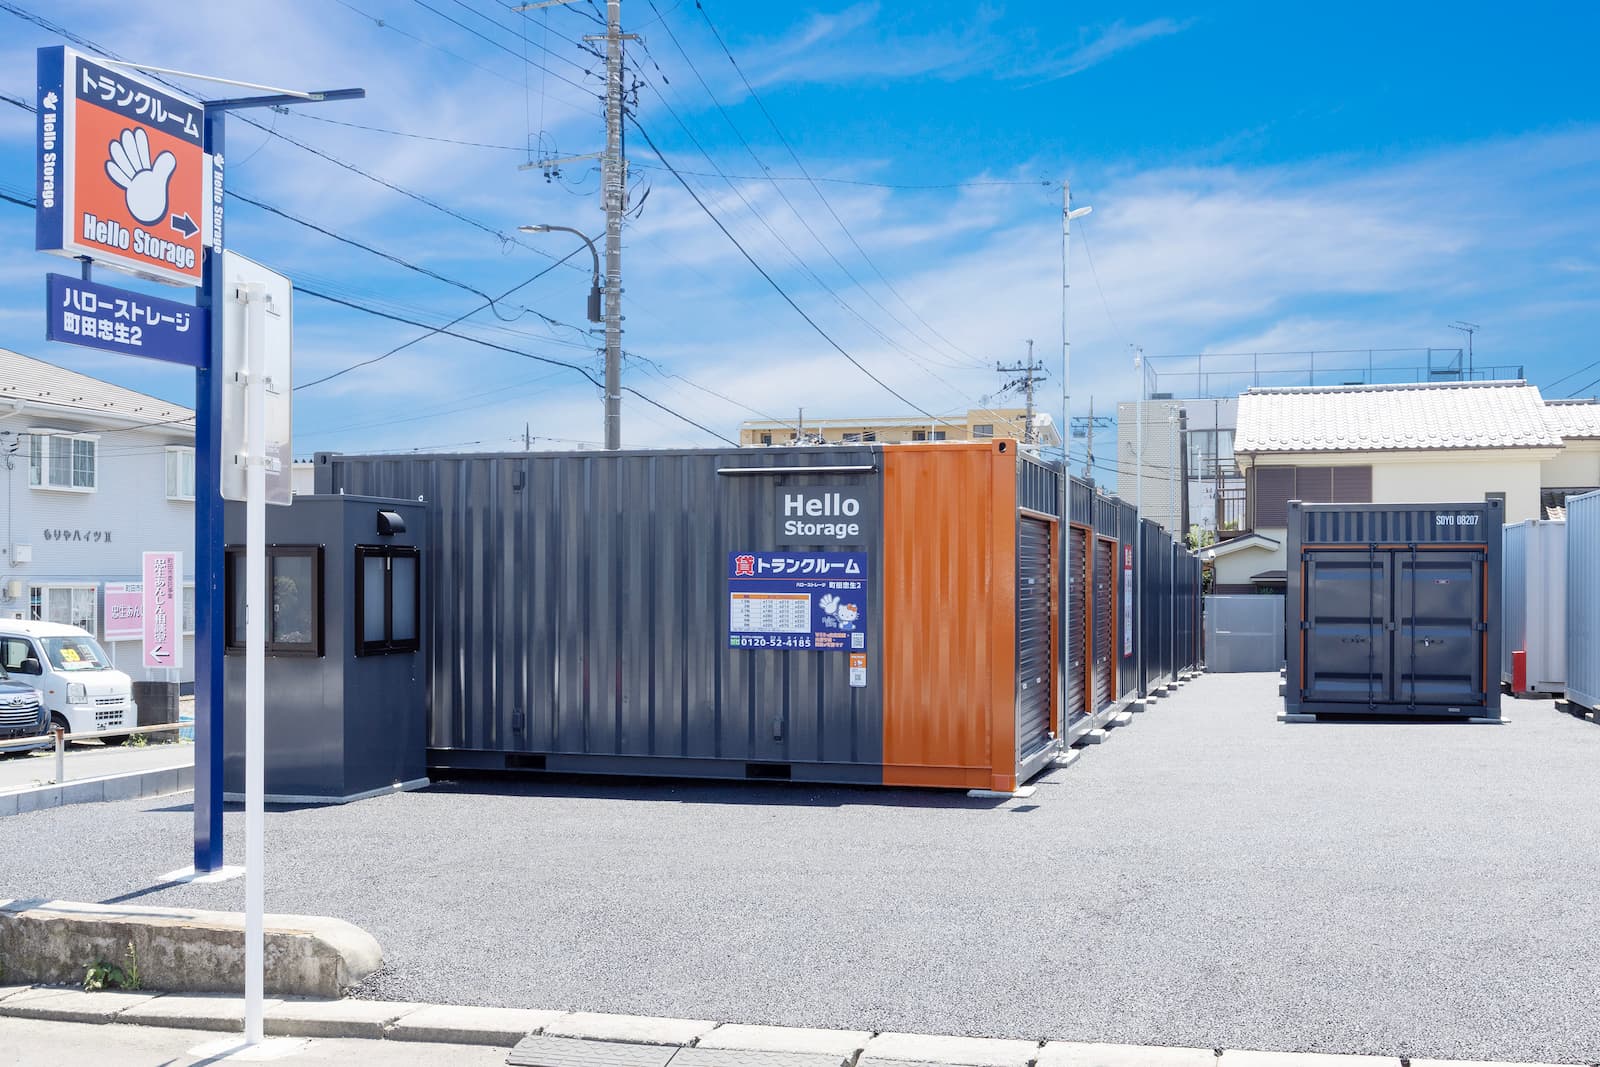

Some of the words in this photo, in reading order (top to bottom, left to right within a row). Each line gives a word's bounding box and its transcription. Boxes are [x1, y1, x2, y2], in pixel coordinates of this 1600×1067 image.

[82, 68, 199, 138] トランクルーム
[43, 113, 57, 150] Hello
[43, 152, 55, 208] Storage
[214, 171, 223, 203] Hello
[83, 213, 130, 250] Hello
[133, 227, 195, 269] Storage
[213, 205, 223, 254] Storage
[63, 287, 190, 332] ハローストレージ
[63, 314, 142, 346] 町田忠生2
[784, 493, 860, 517] Hello
[1457, 515, 1479, 525] 08207
[784, 521, 859, 539] Storage
[741, 638, 811, 648] 0120-52-4185
